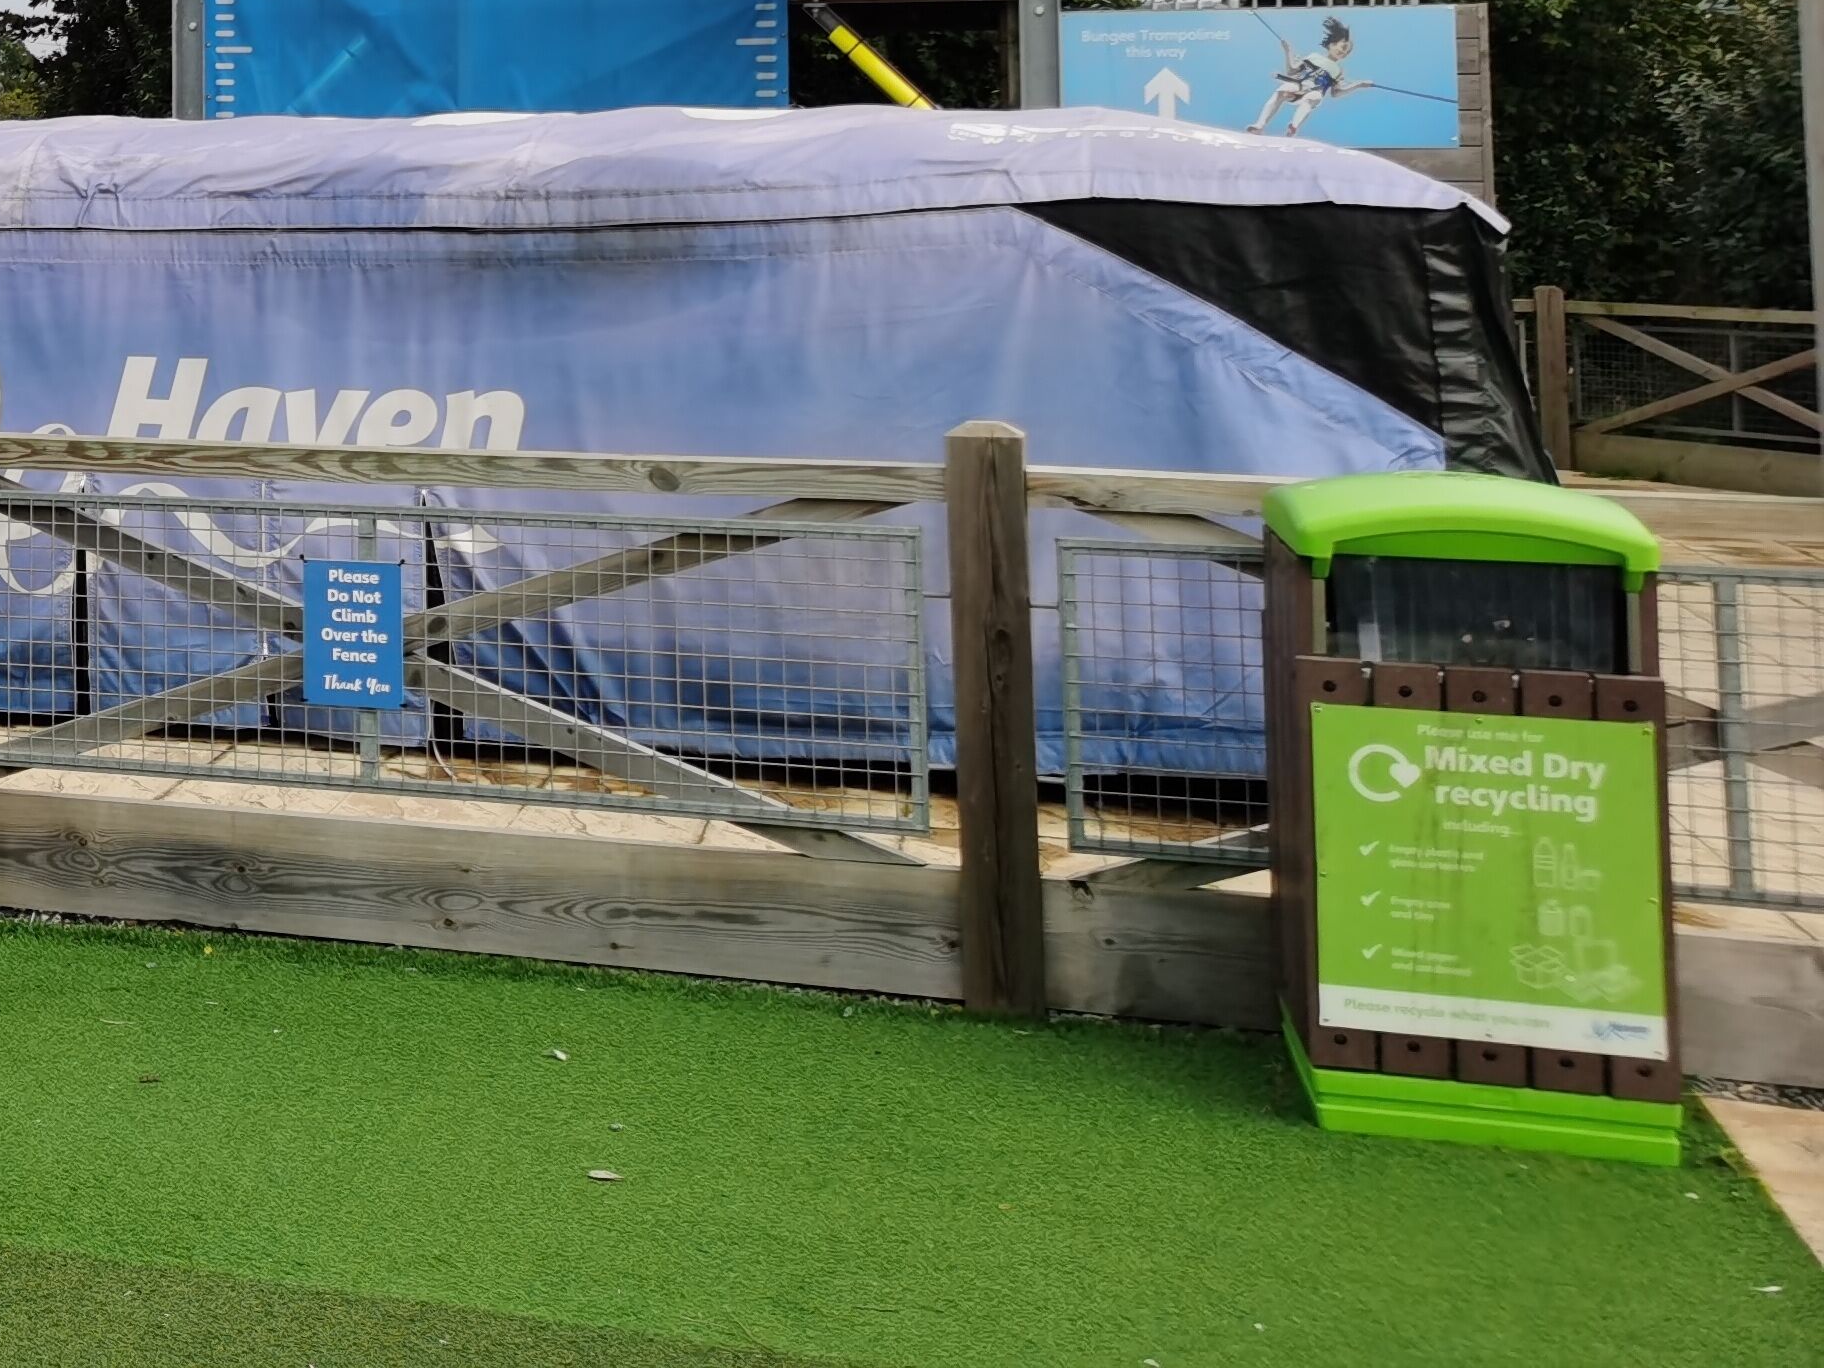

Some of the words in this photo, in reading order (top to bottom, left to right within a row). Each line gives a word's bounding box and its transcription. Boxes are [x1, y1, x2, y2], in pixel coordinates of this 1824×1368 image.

[1081, 30, 1136, 45] Bungee
[1140, 28, 1232, 43] Trampolines
[1126, 46, 1152, 58] this
[1156, 48, 1186, 60] way
[107, 355, 525, 451] Haven
[328, 569, 380, 584] Please
[327, 589, 349, 602] Do
[352, 590, 382, 604] Not
[331, 608, 376, 624] Climb
[321, 628, 360, 642] Over
[361, 629, 388, 644] the
[332, 648, 377, 663] Fence
[322, 674, 363, 691] Thank
[366, 677, 391, 695] You
[1425, 745, 1533, 777] Mixed
[1543, 752, 1606, 789] Dry
[1434, 783, 1598, 822] recycling
[1344, 998, 1391, 1014] Please
